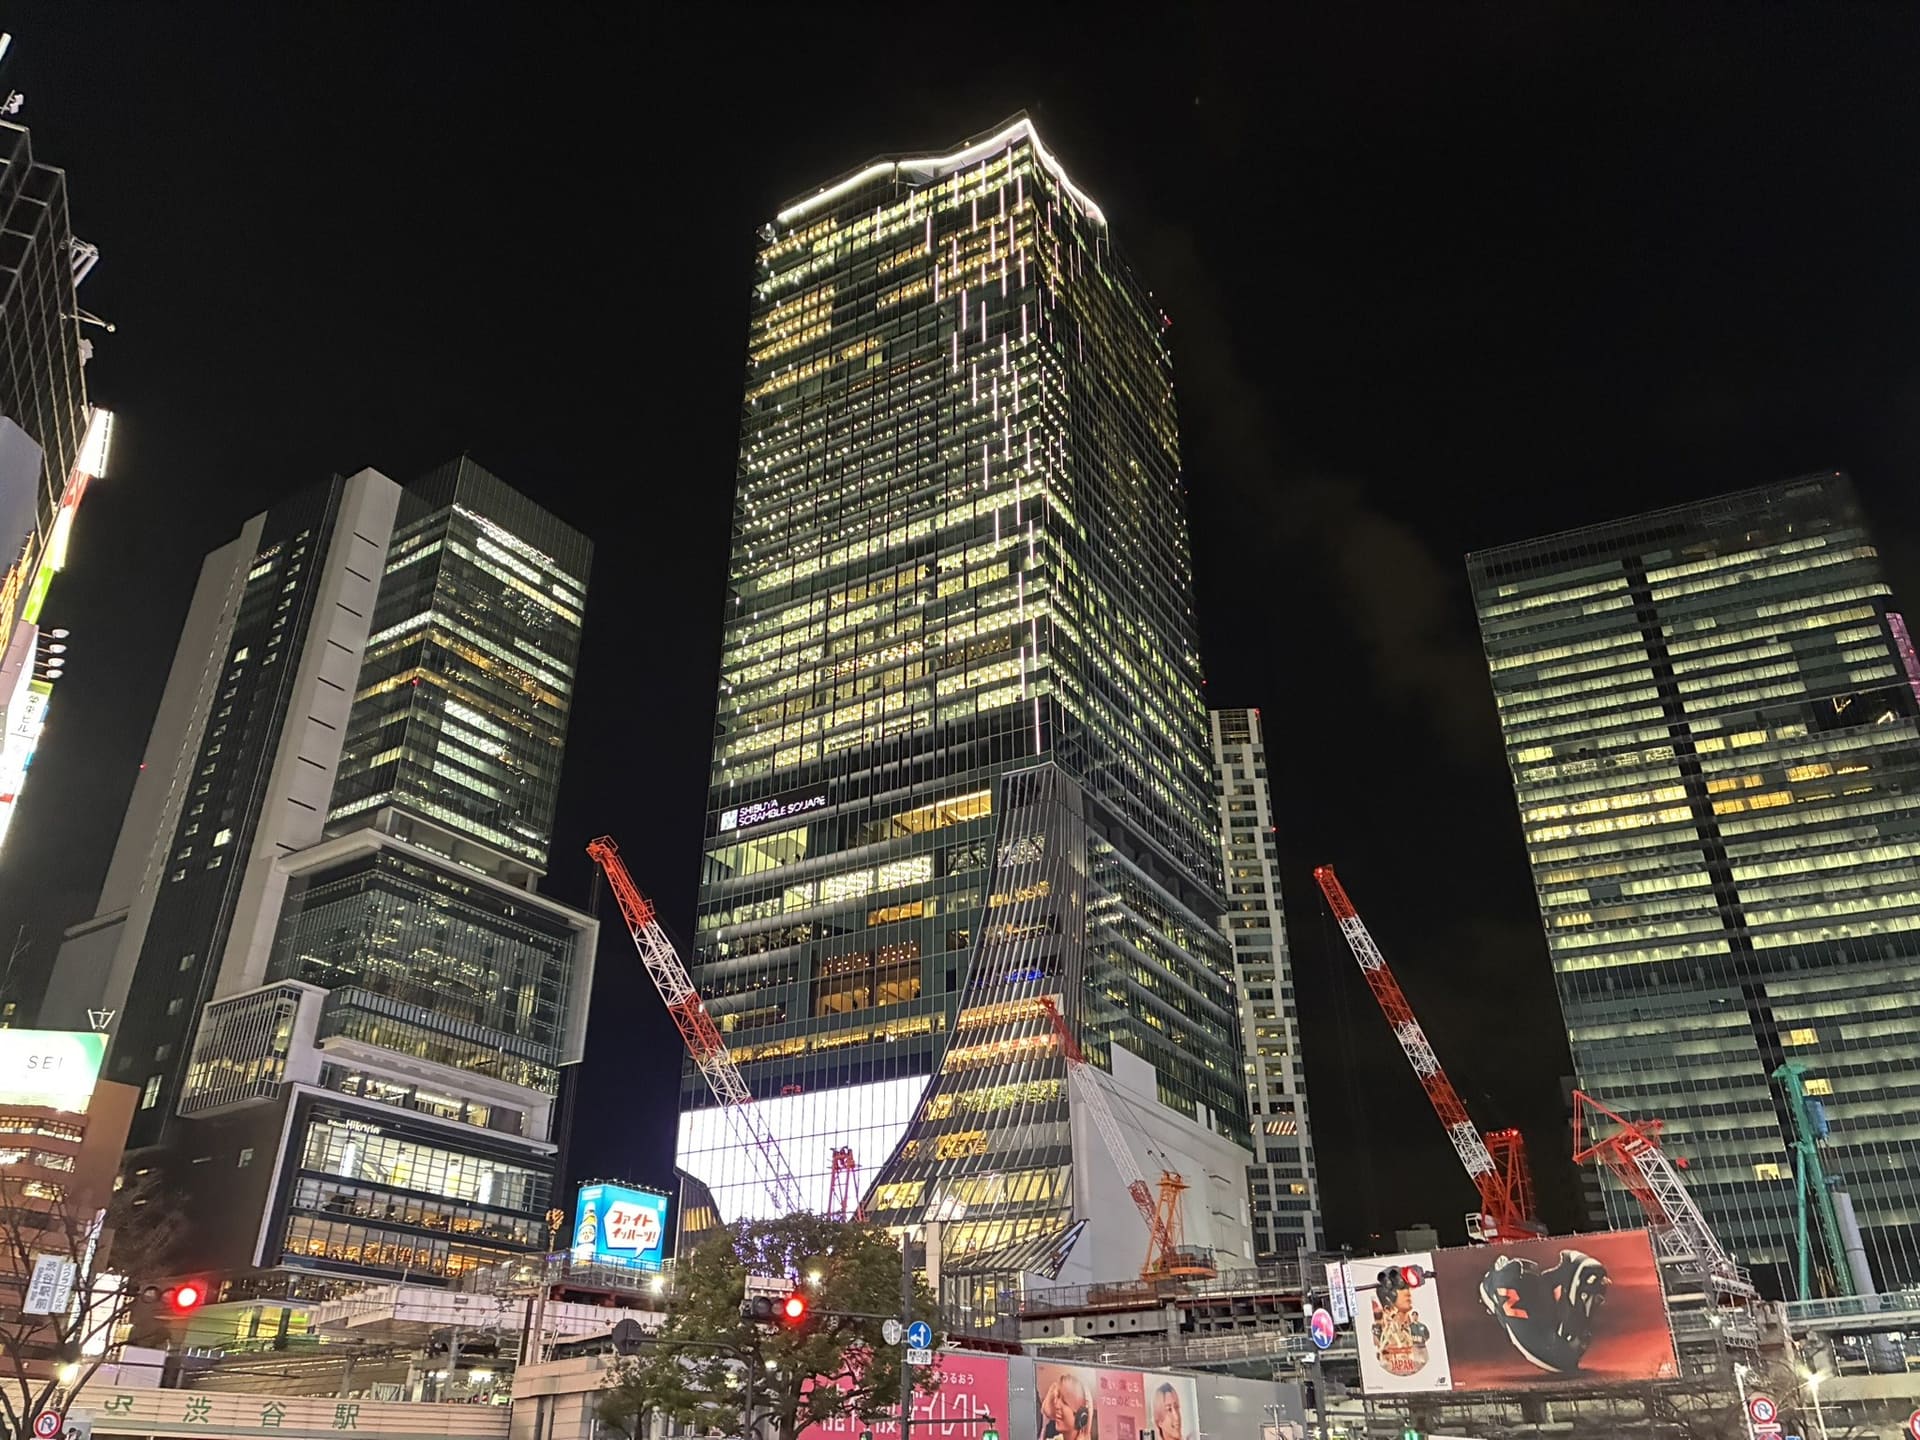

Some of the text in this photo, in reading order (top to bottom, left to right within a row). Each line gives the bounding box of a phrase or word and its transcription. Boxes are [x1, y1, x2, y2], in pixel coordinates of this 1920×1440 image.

[738, 795, 827, 827] SCRAMBLE SQUARE
[739, 799, 779, 818] SHIBUYA
[612, 1209, 653, 1228] ファイト
[1391, 1359, 1415, 1371] JAPAN
[104, 1394, 361, 1430] JR 渋谷駅
